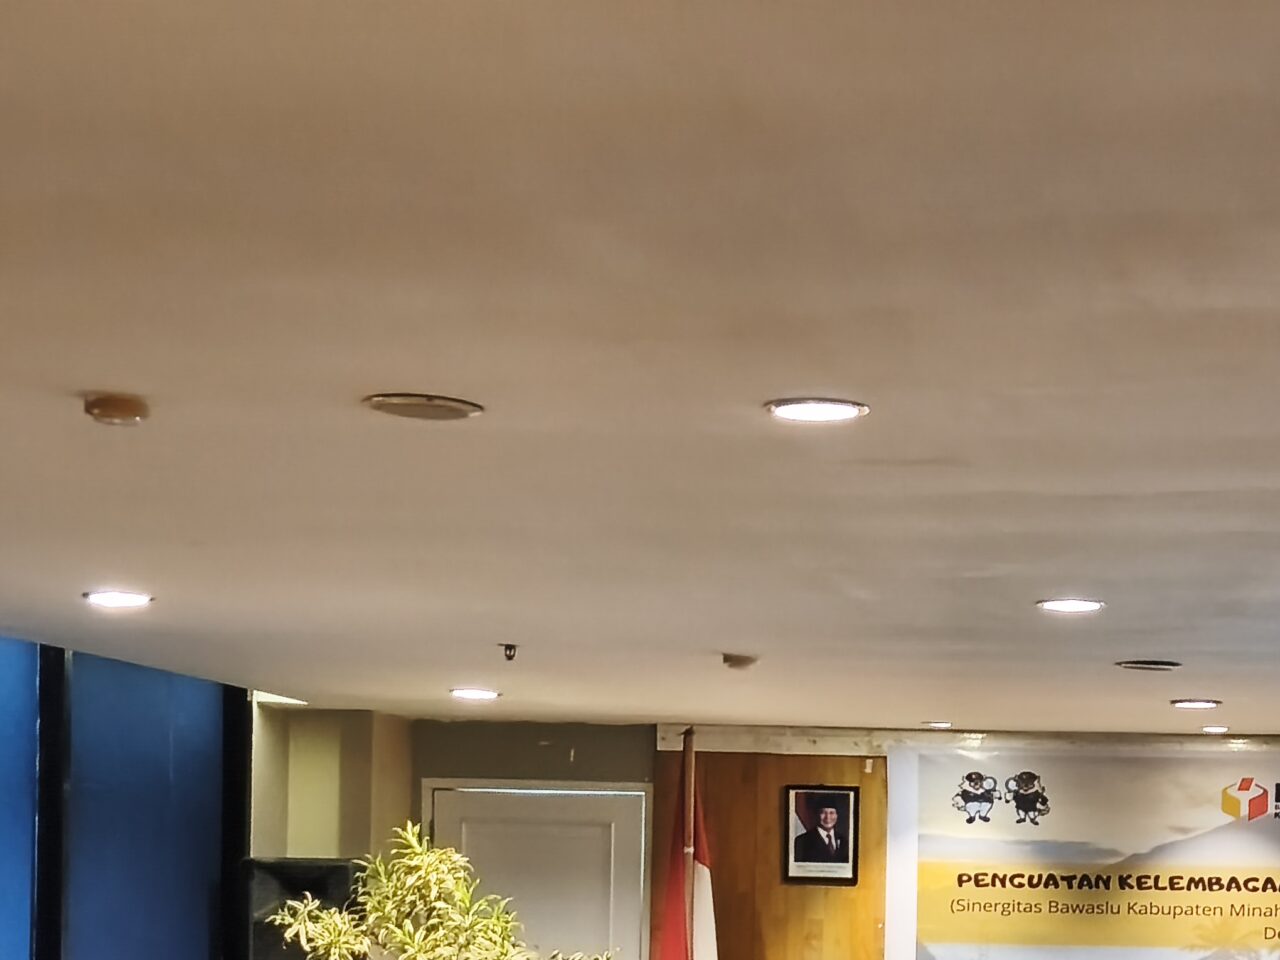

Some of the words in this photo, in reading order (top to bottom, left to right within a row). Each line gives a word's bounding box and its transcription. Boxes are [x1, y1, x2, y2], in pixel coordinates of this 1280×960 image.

[956, 872, 1113, 892] PENGUATAN
[949, 899, 1043, 917] (Sinergitas
[1048, 900, 1121, 915] Bawaslu
[1127, 901, 1224, 920] Kabupaten
